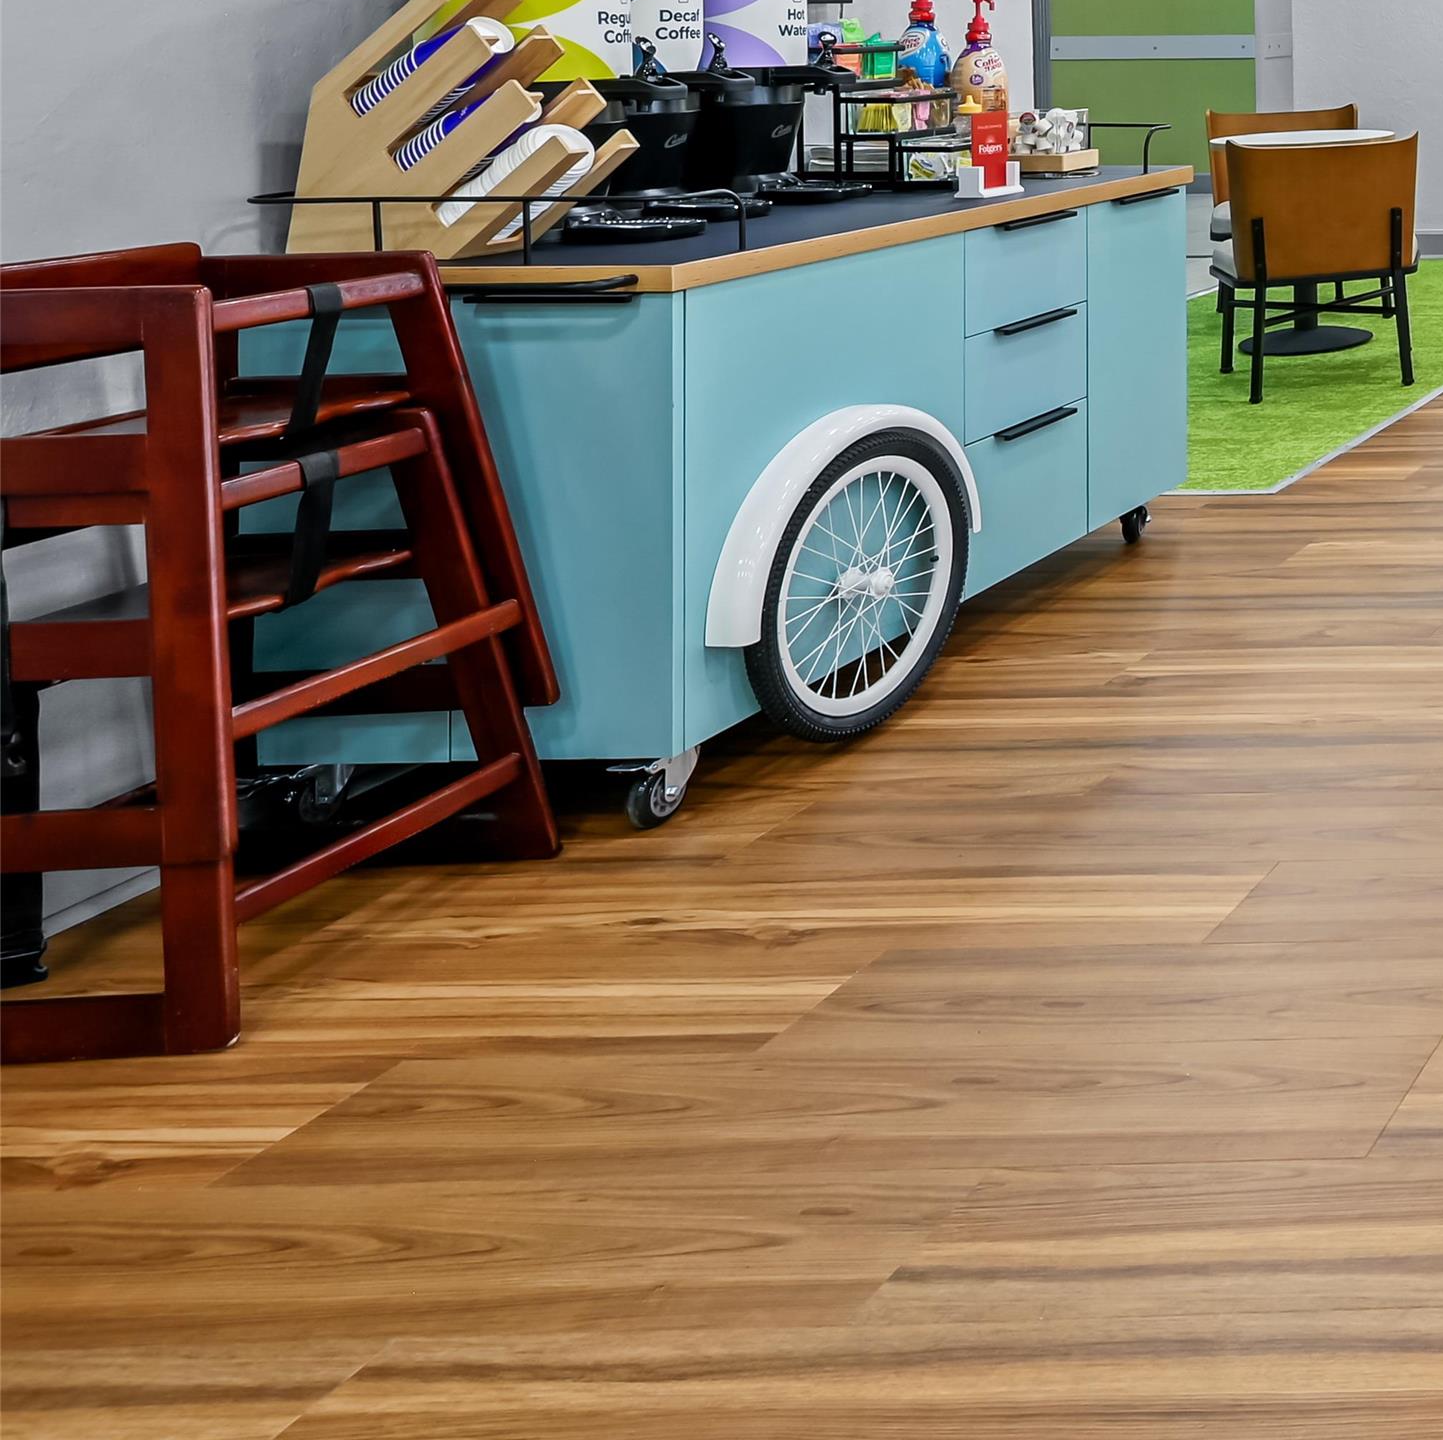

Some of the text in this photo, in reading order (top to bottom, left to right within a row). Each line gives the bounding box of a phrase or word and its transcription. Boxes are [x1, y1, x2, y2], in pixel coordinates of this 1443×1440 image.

[659, 9, 700, 23] Decaf
[788, 8, 805, 20] Hot
[655, 26, 701, 40] Coffee
[978, 143, 1003, 155] Folgers
